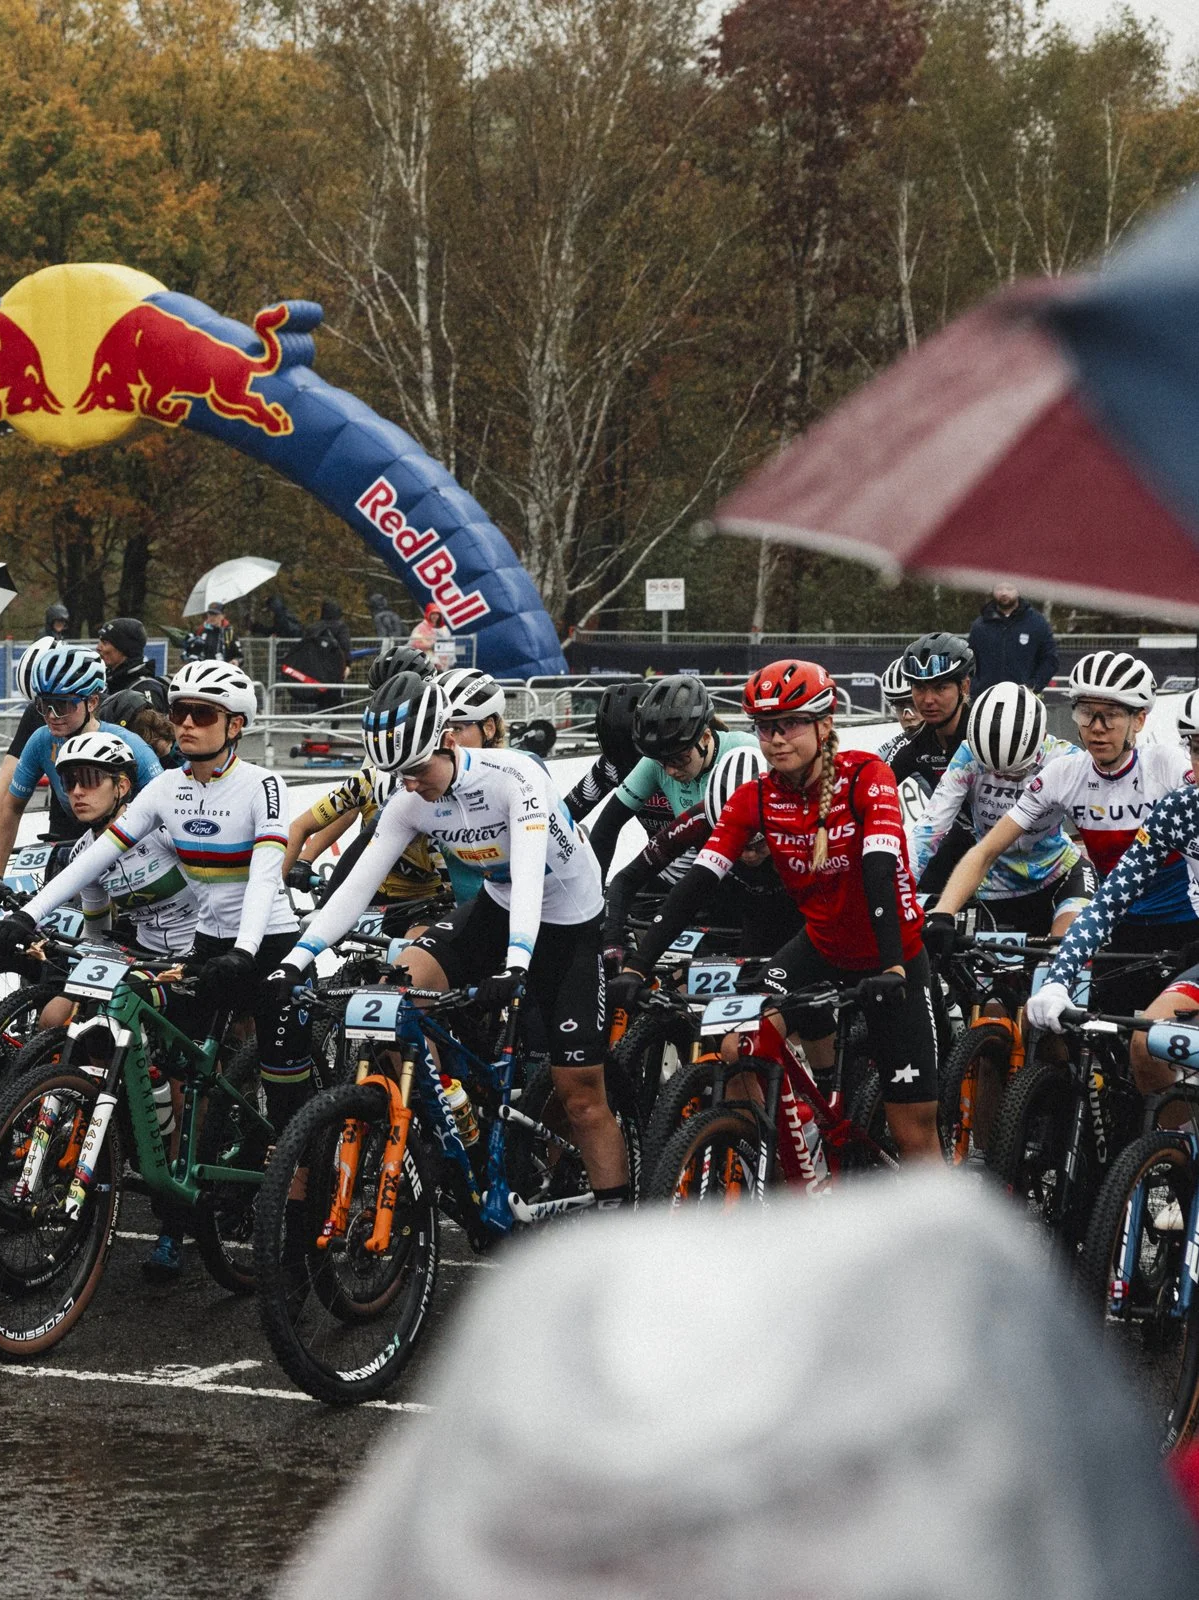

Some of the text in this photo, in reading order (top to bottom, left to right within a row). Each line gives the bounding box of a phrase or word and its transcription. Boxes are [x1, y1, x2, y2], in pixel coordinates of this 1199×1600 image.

[355, 475, 491, 631] Red Bull
[264, 778, 278, 818] MAVIC
[522, 797, 539, 811] 7C
[174, 808, 231, 817] ROCKRIDER
[19, 852, 45, 866] 38
[45, 911, 75, 932] 21
[86, 964, 109, 982] 3
[694, 971, 731, 994] 22
[361, 999, 383, 1023] 2
[721, 999, 745, 1017] 5
[564, 1050, 585, 1062] 7C
[1167, 1034, 1192, 1060] 8
[66, 1116, 103, 1200] MANITOU
[402, 1145, 423, 1201] ICHE
